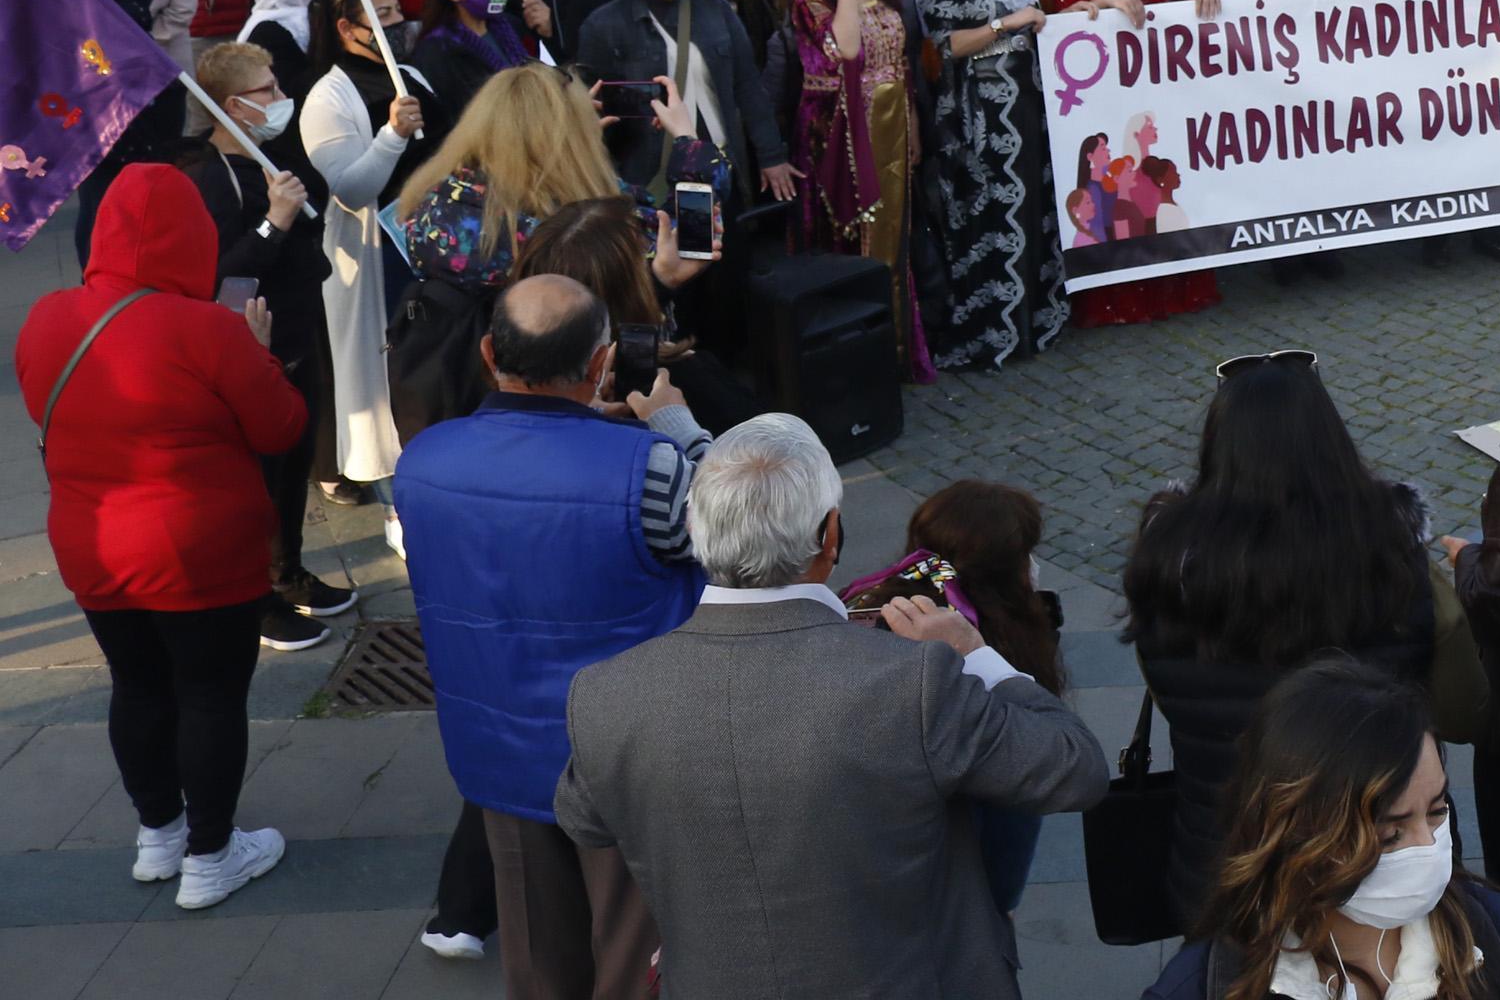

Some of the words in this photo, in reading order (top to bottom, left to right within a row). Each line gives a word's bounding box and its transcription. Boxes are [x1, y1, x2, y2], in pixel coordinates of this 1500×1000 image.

[1116, 0, 1300, 87] DİRENİŞ
[1186, 92, 1404, 171] KADINLAR
[1231, 208, 1374, 248] ANTALYA
[1391, 192, 1489, 225] KADIN
